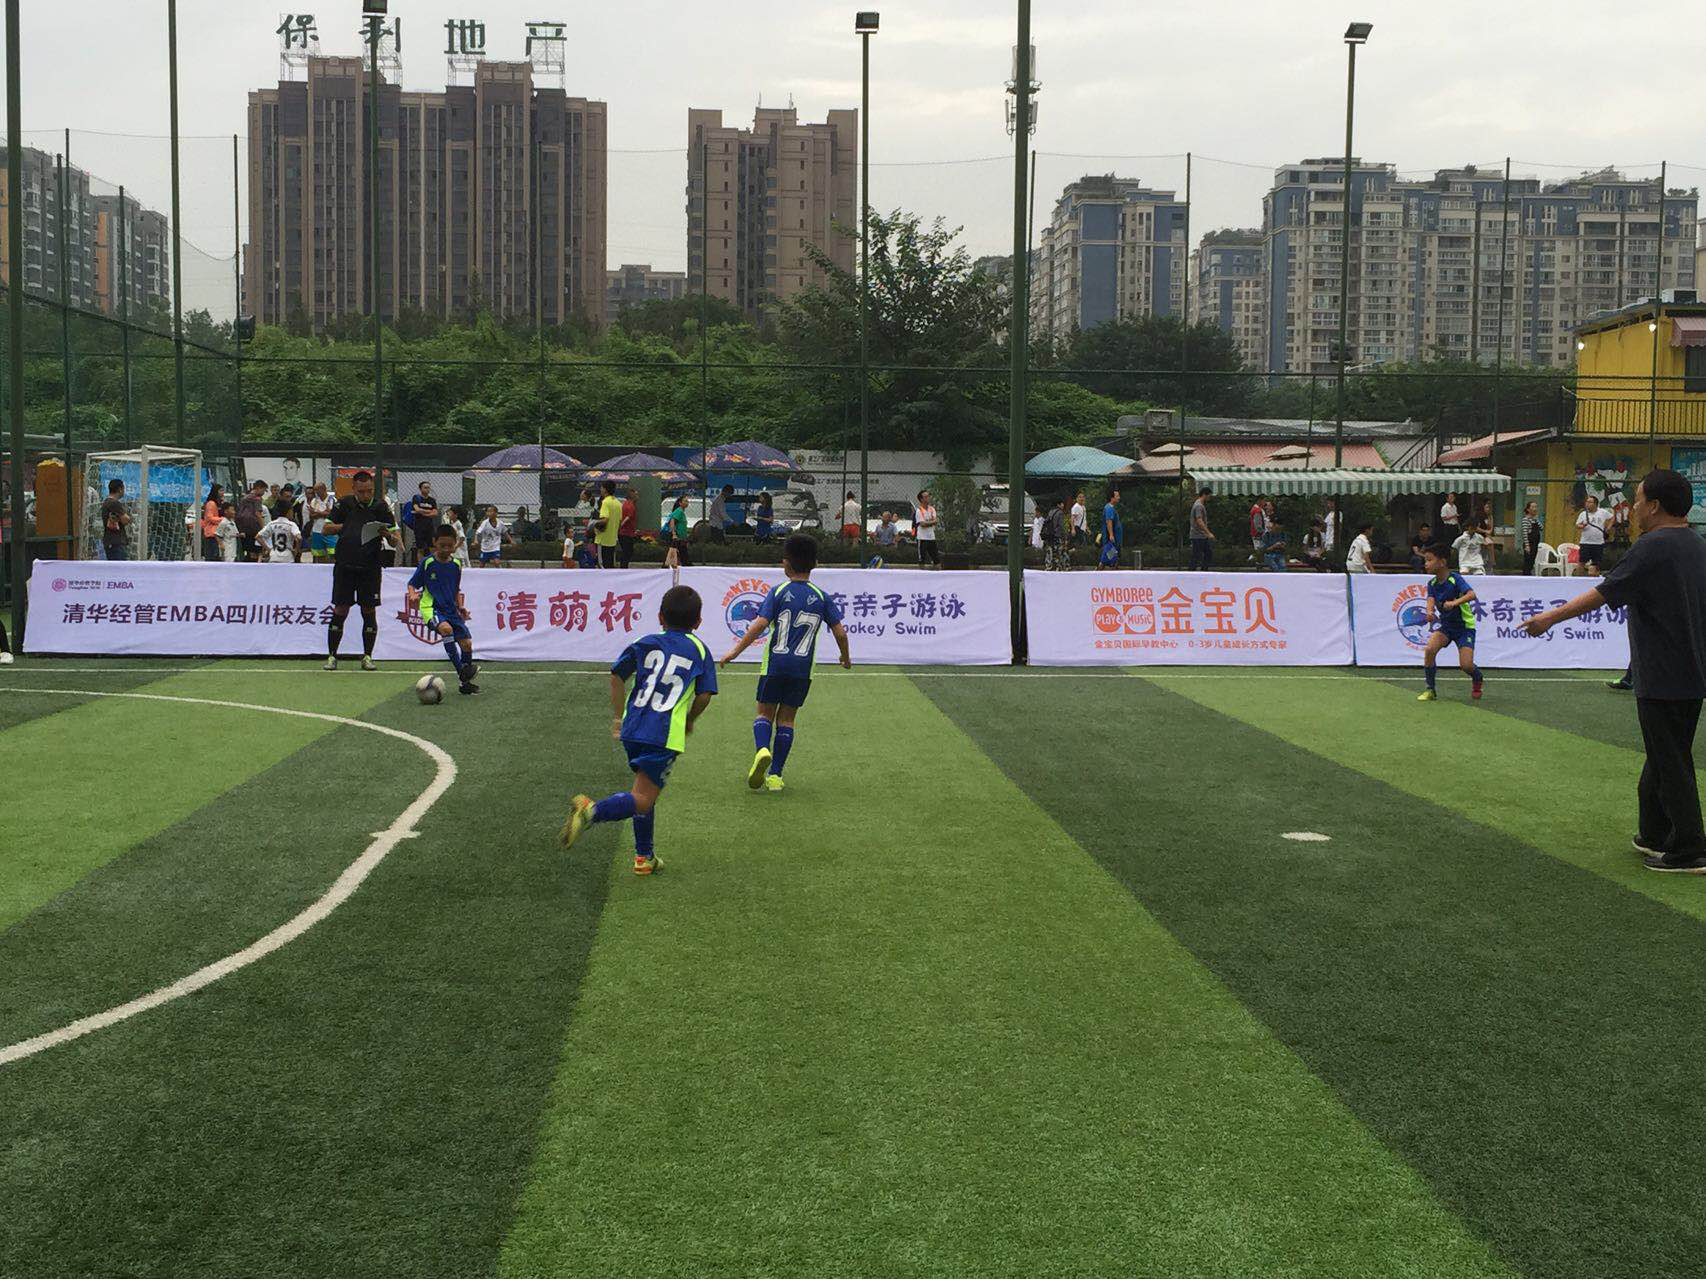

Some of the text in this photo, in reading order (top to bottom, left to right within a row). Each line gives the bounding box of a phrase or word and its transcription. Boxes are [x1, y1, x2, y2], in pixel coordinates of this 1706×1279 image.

[276, 14, 568, 57] 保利地产
[272, 533, 288, 552] 13
[107, 581, 134, 589] EMBA
[62, 603, 336, 625] 清华经管EMBA四川校友会
[496, 591, 643, 633] 清萌杯
[1158, 586, 1278, 634] 金宝贝
[772, 609, 820, 657] 17
[827, 622, 937, 637] ookey Swim
[1496, 626, 1605, 642] Mooy Swim
[634, 649, 694, 713] 35
